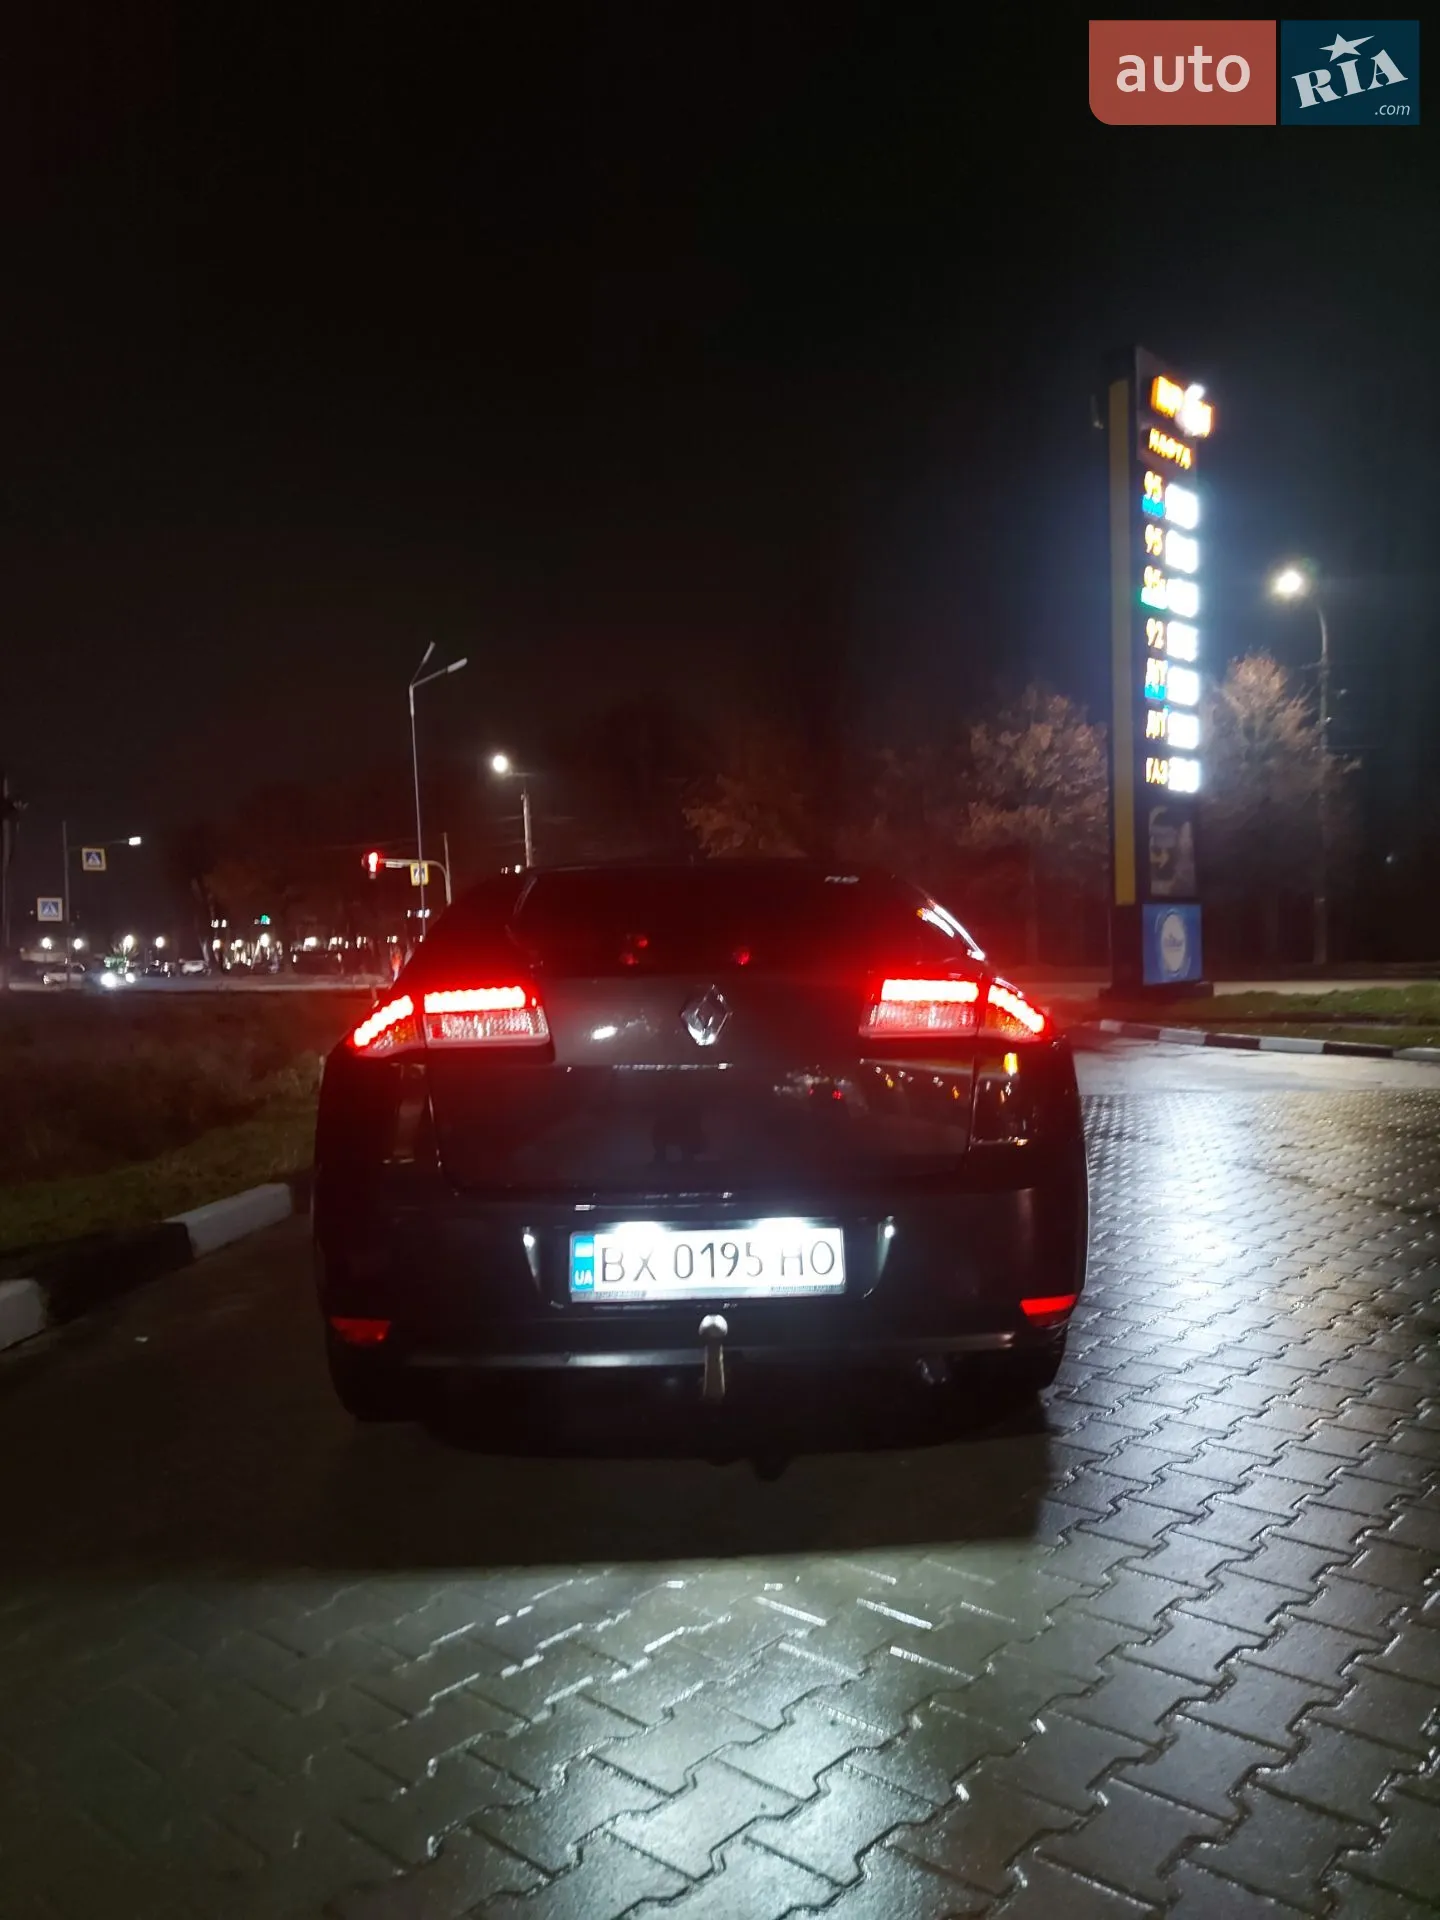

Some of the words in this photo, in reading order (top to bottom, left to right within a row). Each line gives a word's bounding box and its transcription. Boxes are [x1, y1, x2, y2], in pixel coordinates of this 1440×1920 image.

[1146, 618, 1164, 649] 92
[601, 1247, 656, 1282] BX
[674, 1242, 763, 1279] 0195
[780, 1241, 835, 1276] HO
[574, 1269, 593, 1286] UA
